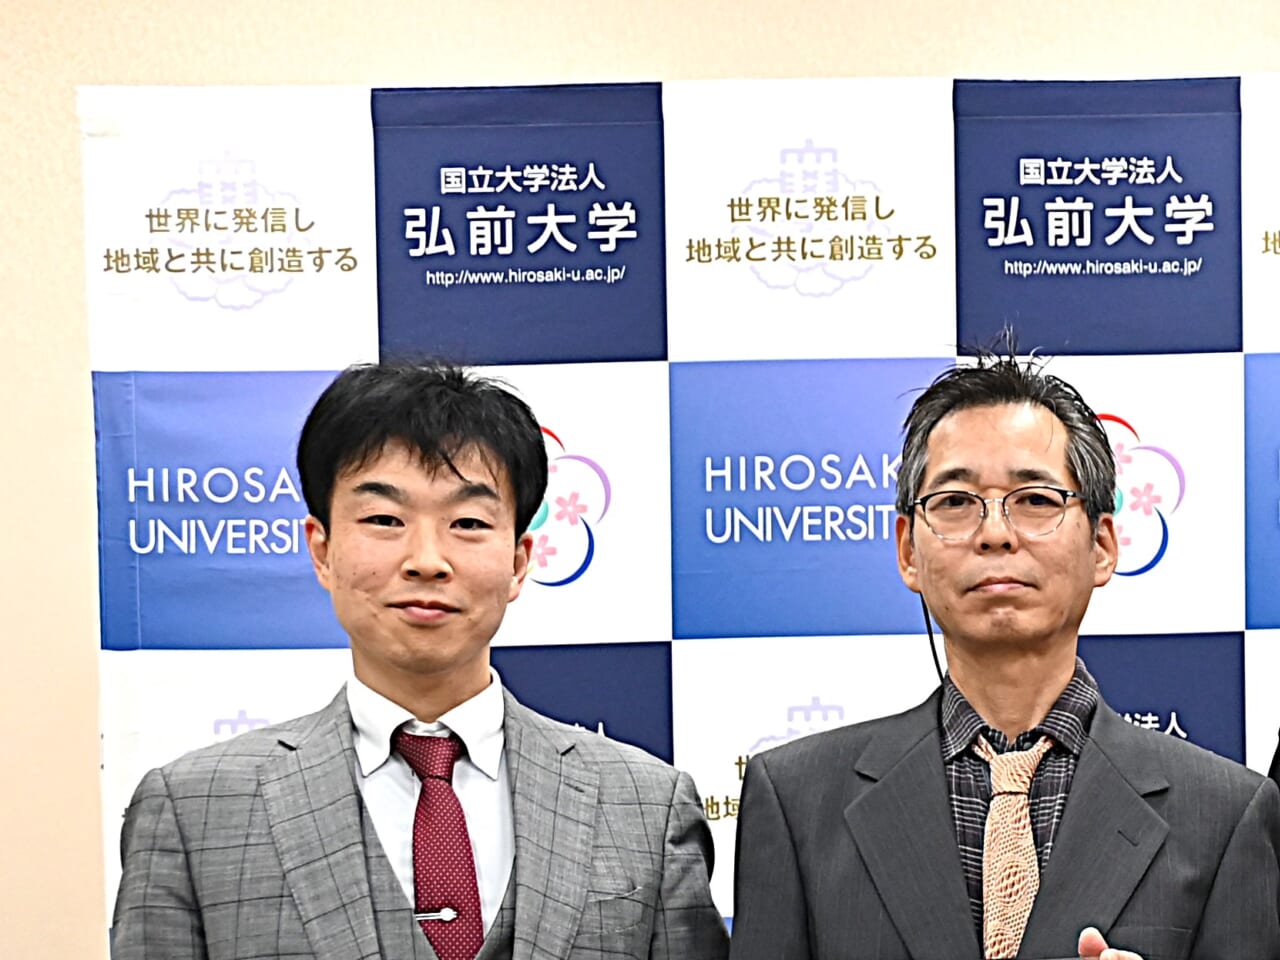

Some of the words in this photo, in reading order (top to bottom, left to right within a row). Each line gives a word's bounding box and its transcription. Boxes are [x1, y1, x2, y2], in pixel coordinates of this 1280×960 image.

[440, 163, 605, 194] 国立大学法人
[1019, 156, 1183, 186] 国立大学法人
[145, 207, 315, 234] 世界に発信し
[727, 195, 895, 223] 世界に発信し
[983, 194, 1214, 246] 弘前大学
[404, 201, 637, 257] 弘前大学
[103, 247, 358, 274] 地域と共に創造する
[685, 234, 937, 264] 地域と共に創造する
[426, 266, 626, 287] http://www.hirosaki-u.ac.jp/
[1004, 257, 1202, 277] http://www.hirosaki-u.ac.jp/
[129, 516, 307, 554] UNIVERSI
